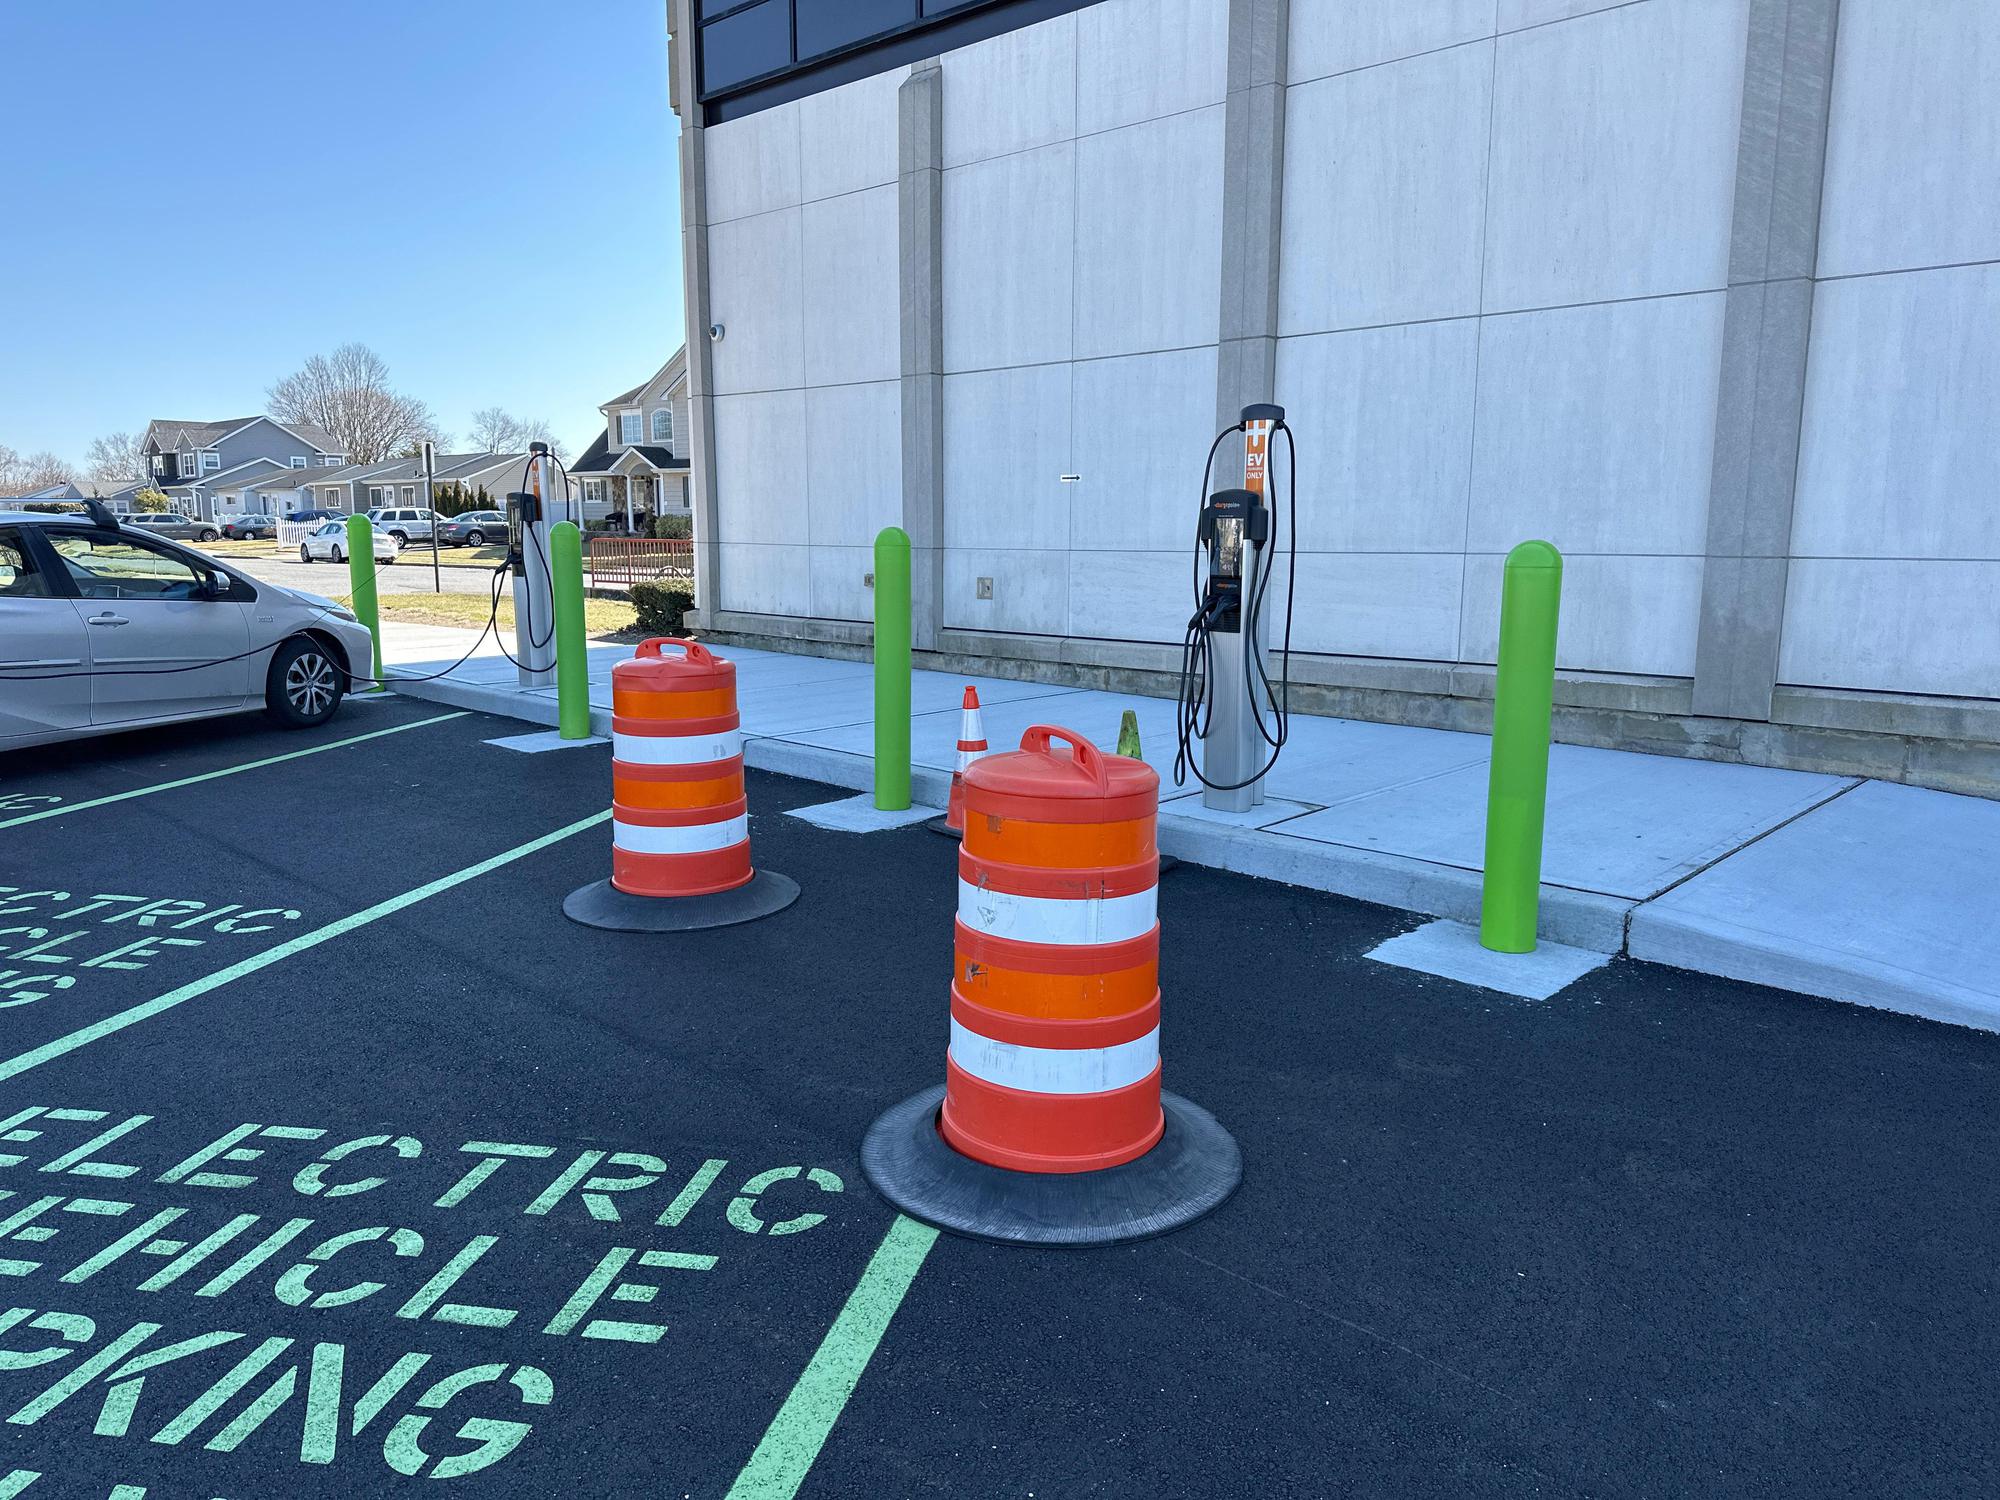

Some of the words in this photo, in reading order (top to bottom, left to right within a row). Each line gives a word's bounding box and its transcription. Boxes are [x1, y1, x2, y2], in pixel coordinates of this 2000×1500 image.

[1247, 471, 1263, 479] ONLY
[1248, 453, 1264, 466] EV
[0, 886, 301, 933] CTRIC
[0, 1106, 844, 1236] ELECTRIC
[0, 1190, 719, 1343] EHICLE
